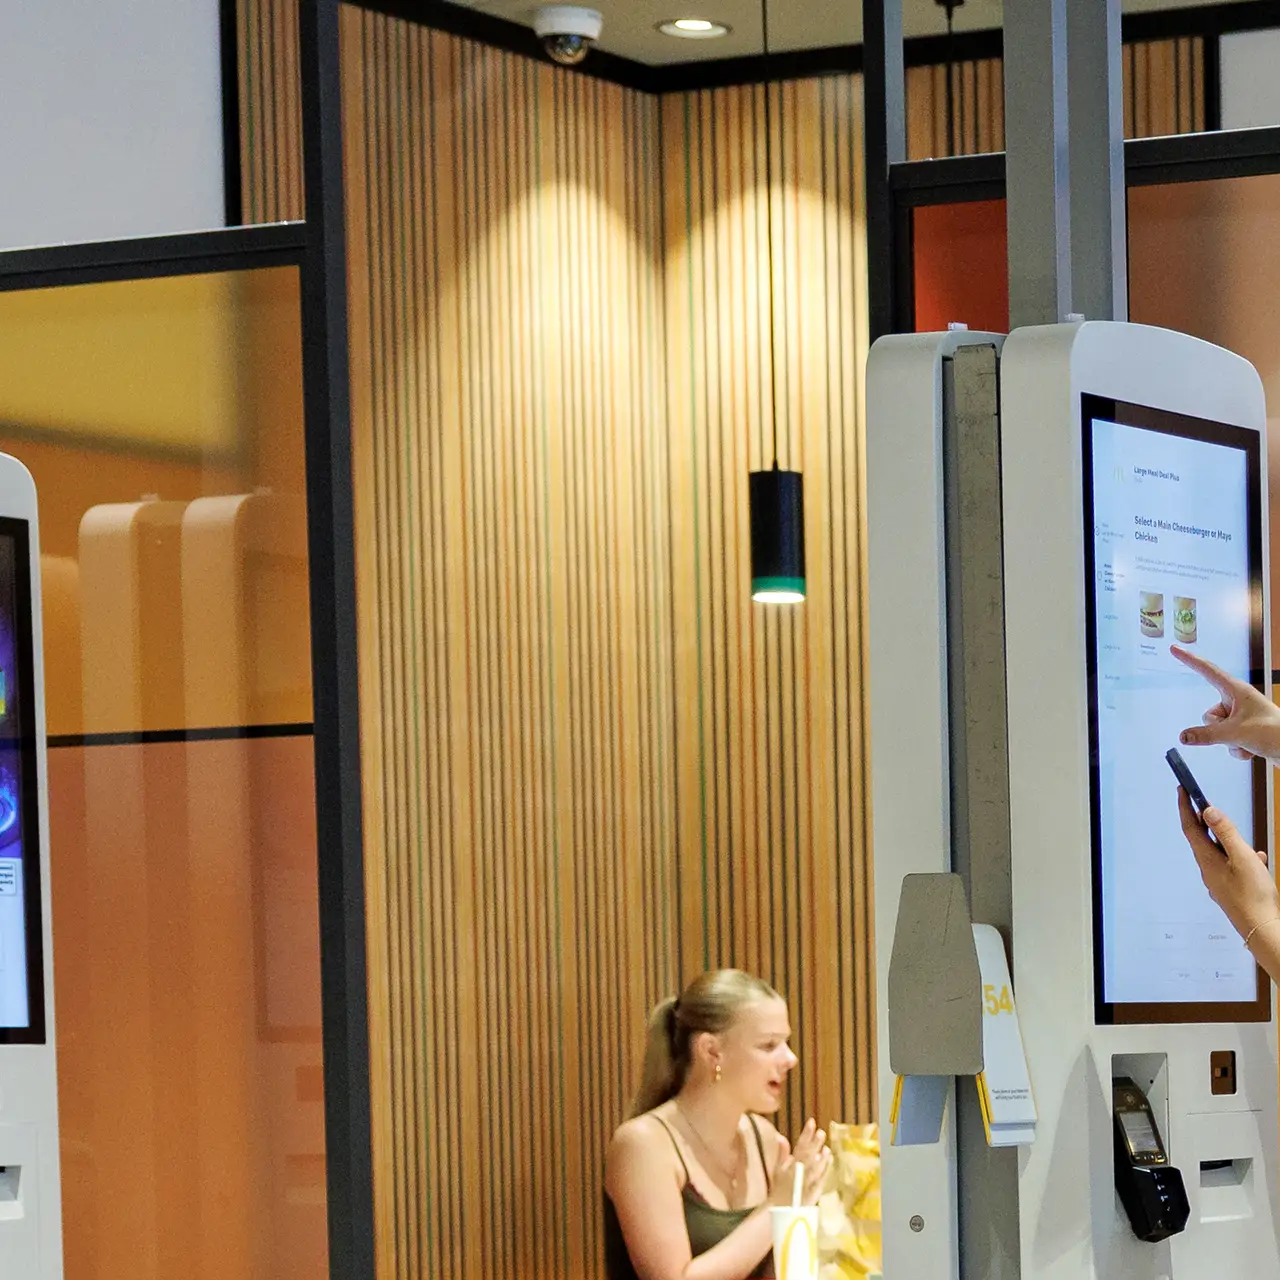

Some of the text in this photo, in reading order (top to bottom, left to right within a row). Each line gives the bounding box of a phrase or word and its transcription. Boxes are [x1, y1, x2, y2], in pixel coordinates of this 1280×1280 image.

[1134, 515, 1153, 527] Select
[1157, 519, 1172, 531] Main
[1172, 522, 1210, 539] Cheeseburger
[1217, 530, 1232, 543] Mayo
[1134, 531, 1159, 544] Chicken
[982, 984, 1014, 1016] 54
